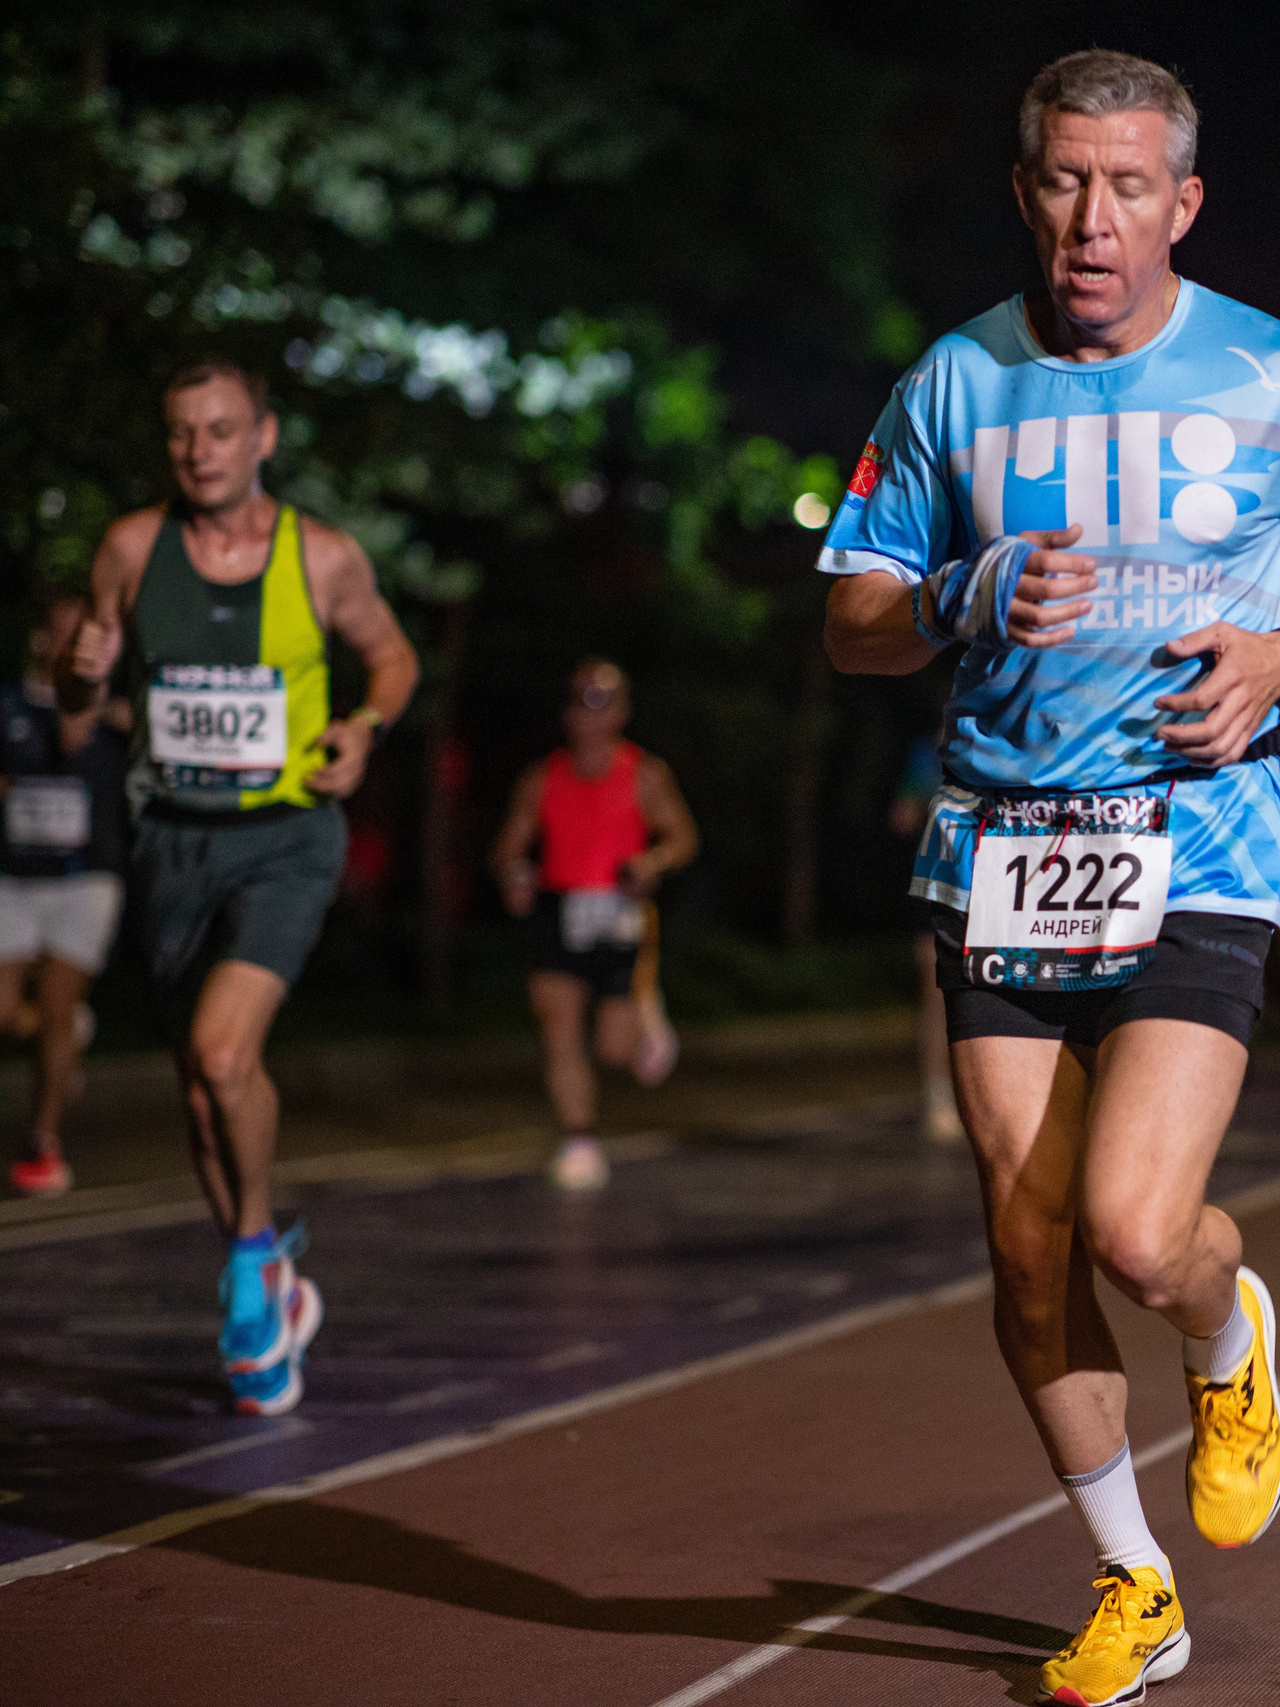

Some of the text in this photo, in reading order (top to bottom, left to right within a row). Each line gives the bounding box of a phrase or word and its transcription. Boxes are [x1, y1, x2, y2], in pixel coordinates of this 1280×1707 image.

[168, 701, 267, 741] 3802
[1006, 853, 1142, 911] 1222
[1030, 917, 1102, 936] АНДРЕЙ
